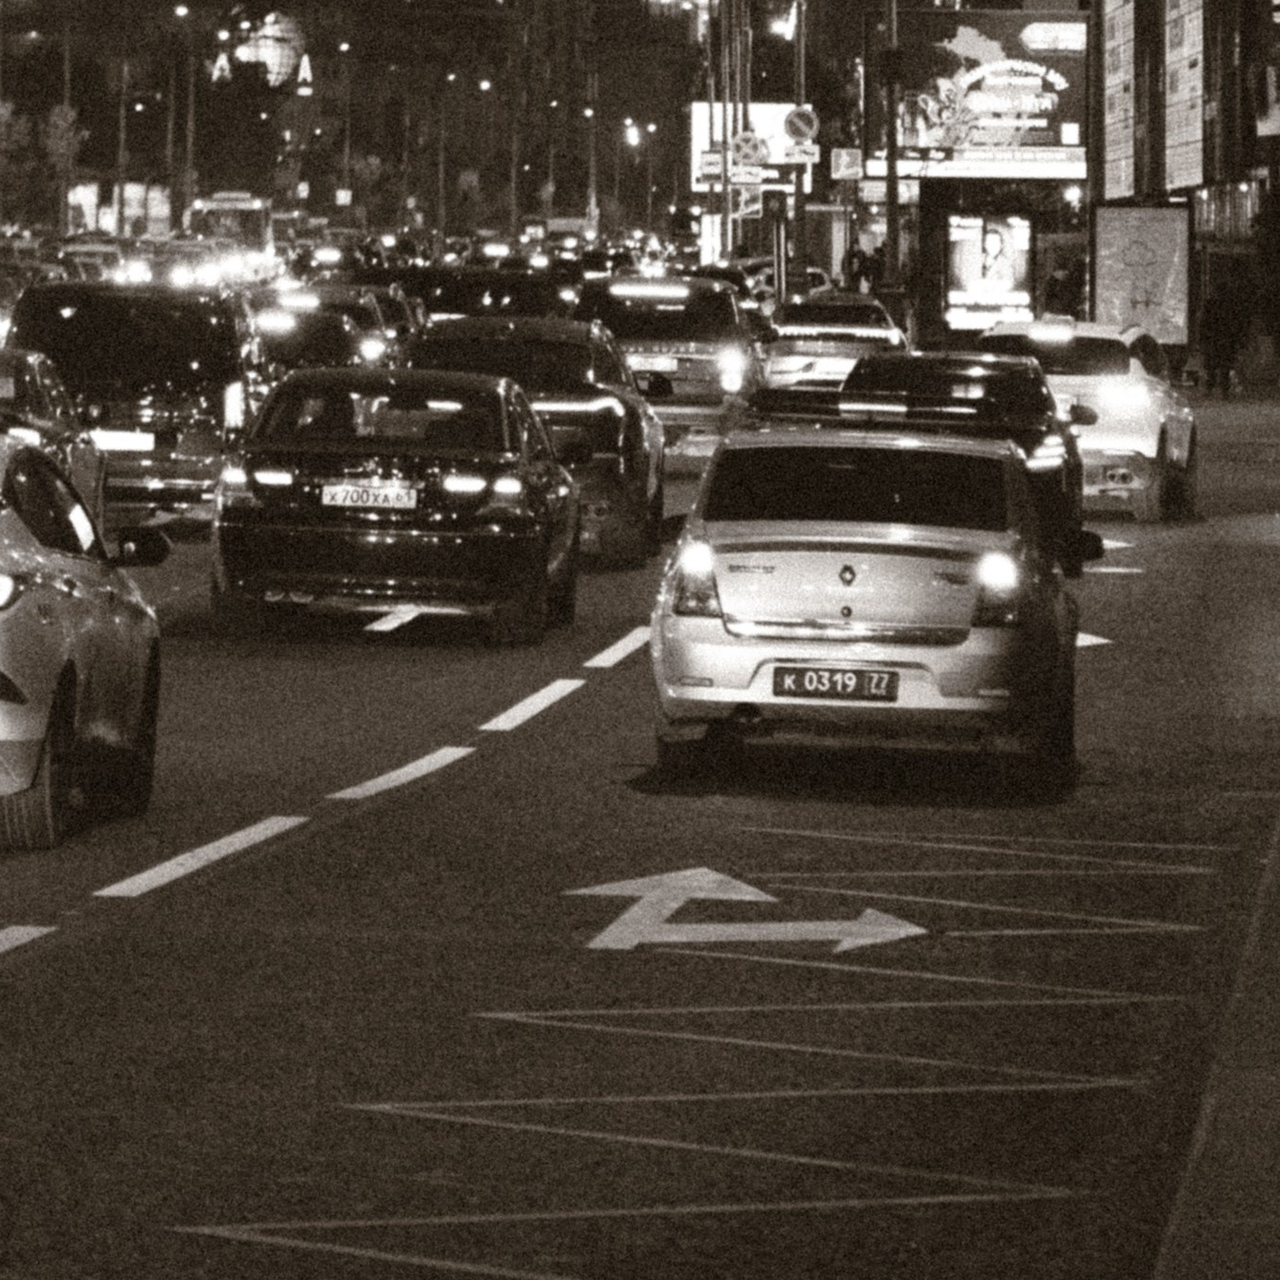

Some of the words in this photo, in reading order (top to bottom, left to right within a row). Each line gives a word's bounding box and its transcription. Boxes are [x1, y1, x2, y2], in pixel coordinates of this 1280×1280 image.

[783, 673, 796, 690] К
[804, 671, 857, 693] 0319
[869, 672, 890, 689] 77
